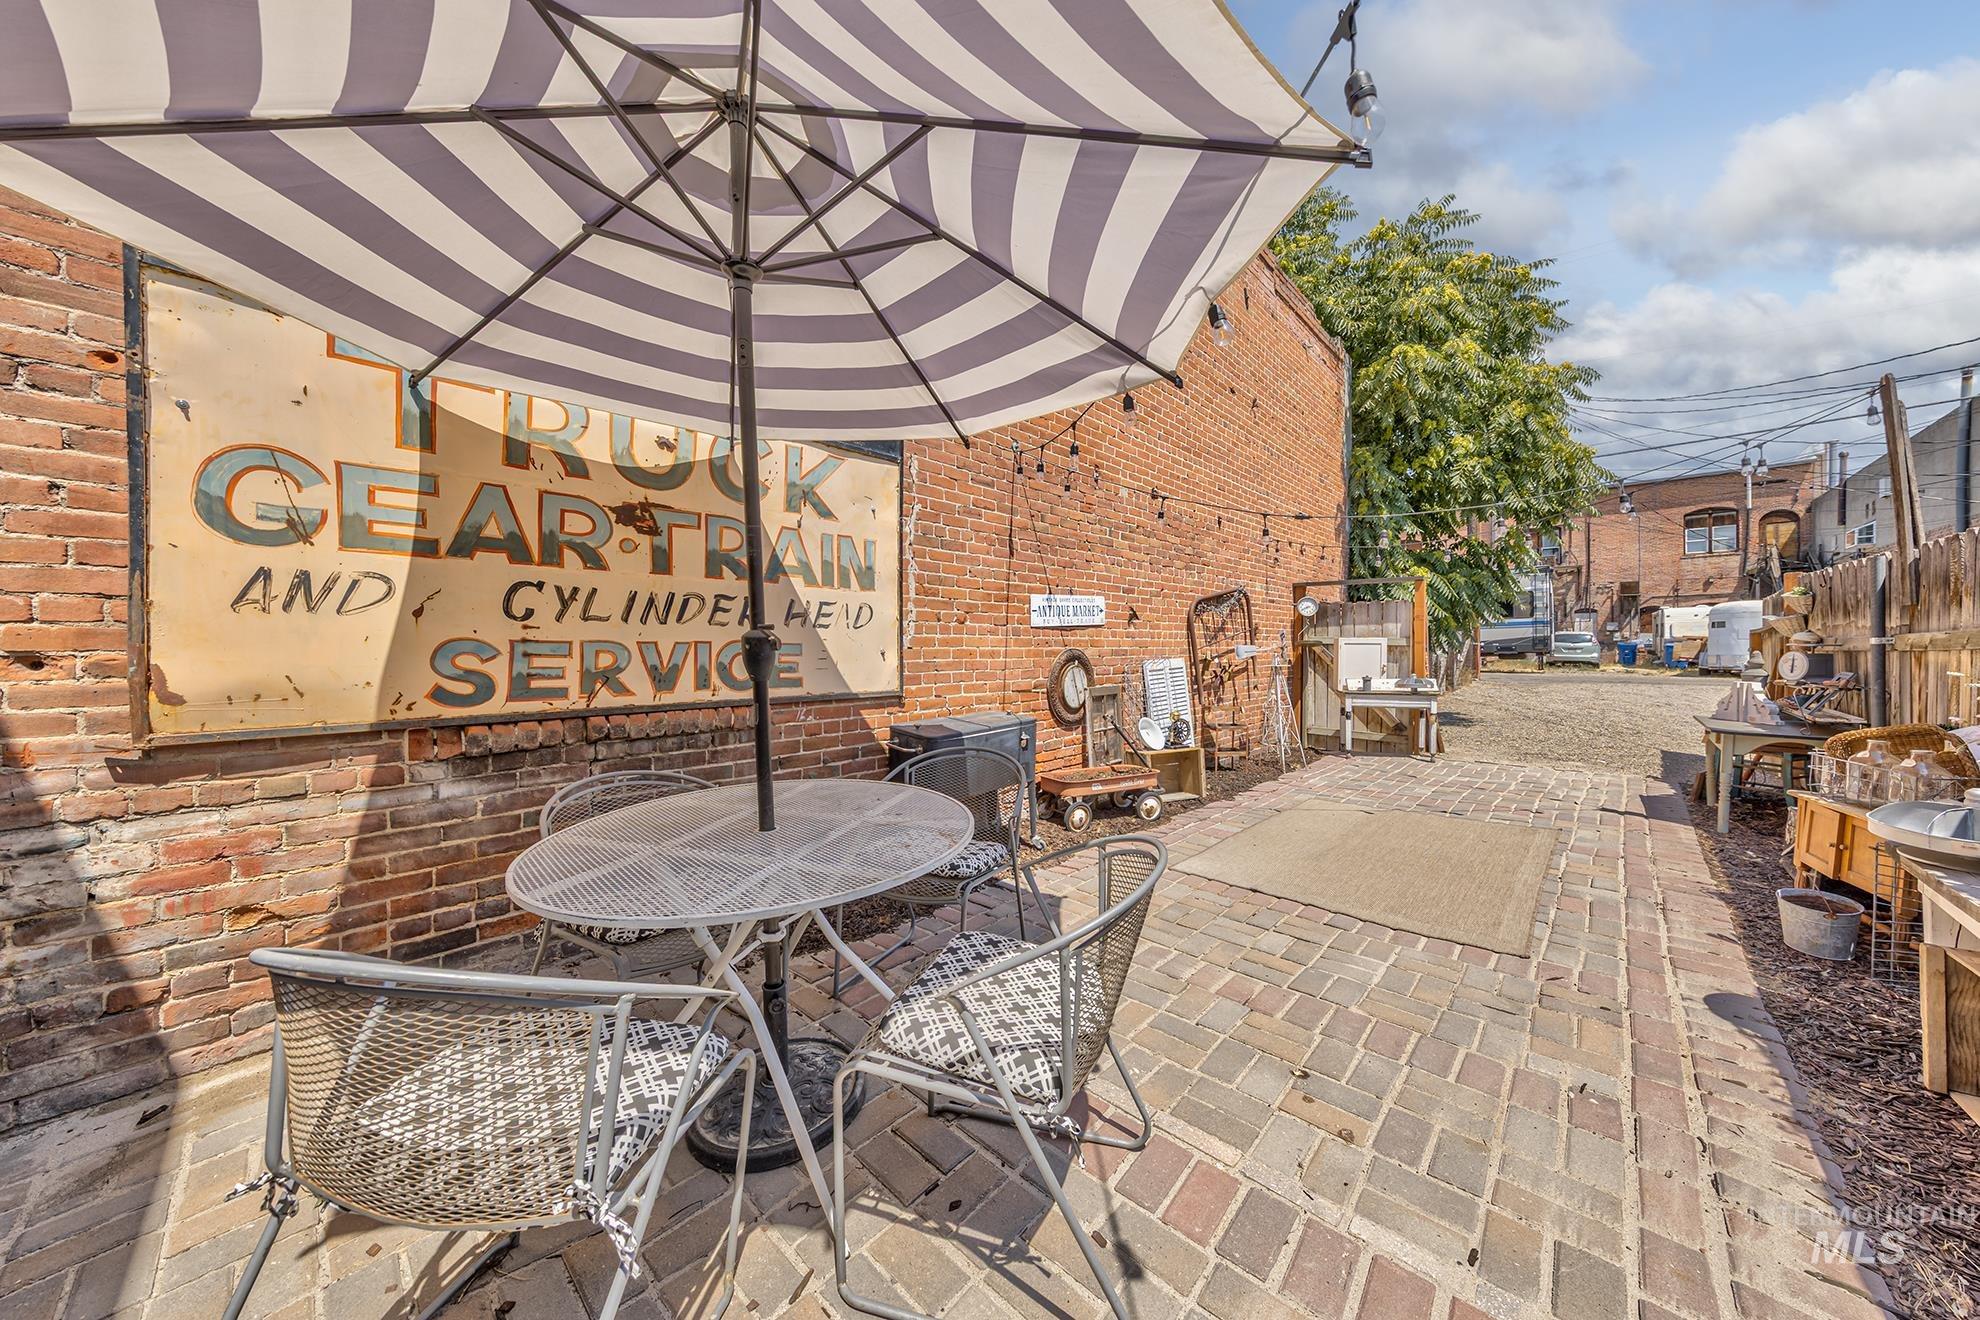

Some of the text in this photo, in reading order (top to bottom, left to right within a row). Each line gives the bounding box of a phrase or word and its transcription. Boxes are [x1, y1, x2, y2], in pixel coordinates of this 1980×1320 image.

[327, 333, 847, 521] TRUCK
[230, 566, 396, 616] AND
[784, 598, 873, 630] HEAD
[1037, 604, 1100, 618] ANTIQUE MARKET
[424, 637, 803, 708] SERVICE
